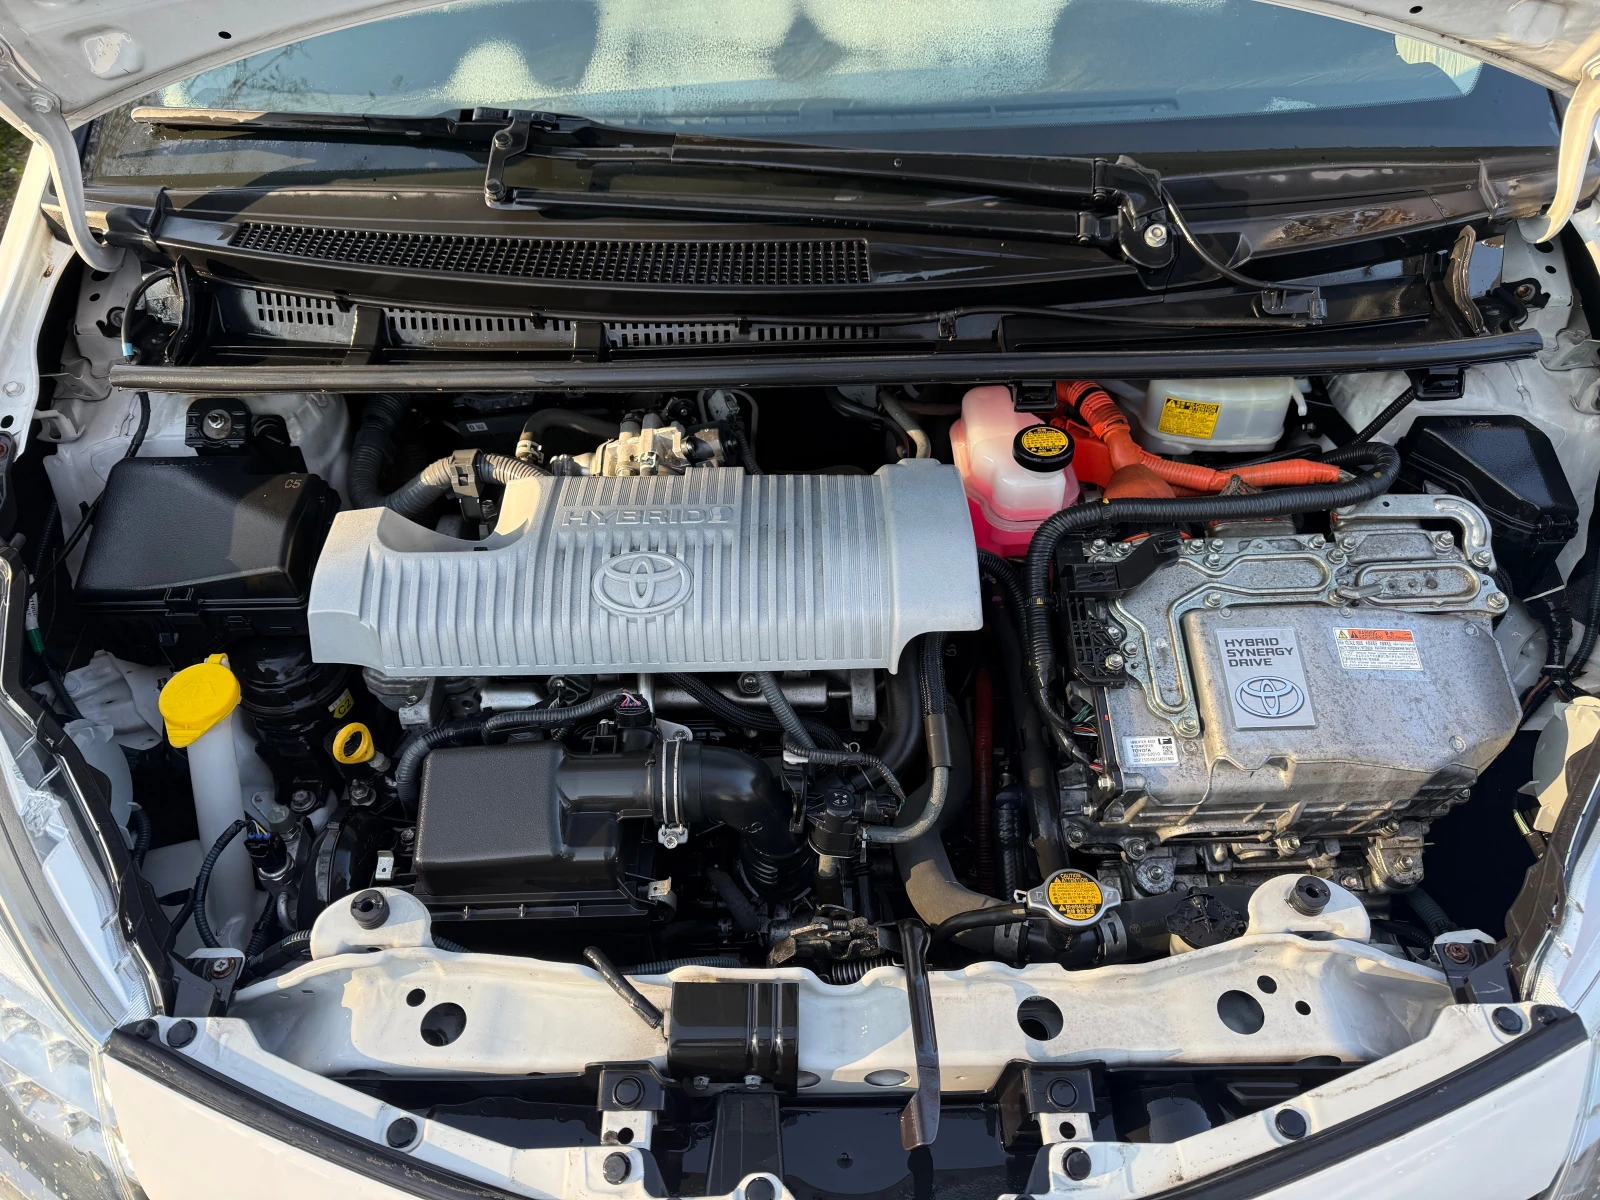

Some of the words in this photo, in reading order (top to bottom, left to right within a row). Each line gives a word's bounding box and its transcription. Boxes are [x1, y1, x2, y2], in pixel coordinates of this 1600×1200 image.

[284, 478, 302, 489] C5
[562, 509, 706, 526] HYBRID
[1224, 637, 1279, 648] HYBRID
[1227, 647, 1294, 657] SYNERGY
[1228, 658, 1273, 667] DRIVE
[338, 698, 352, 715] C2
